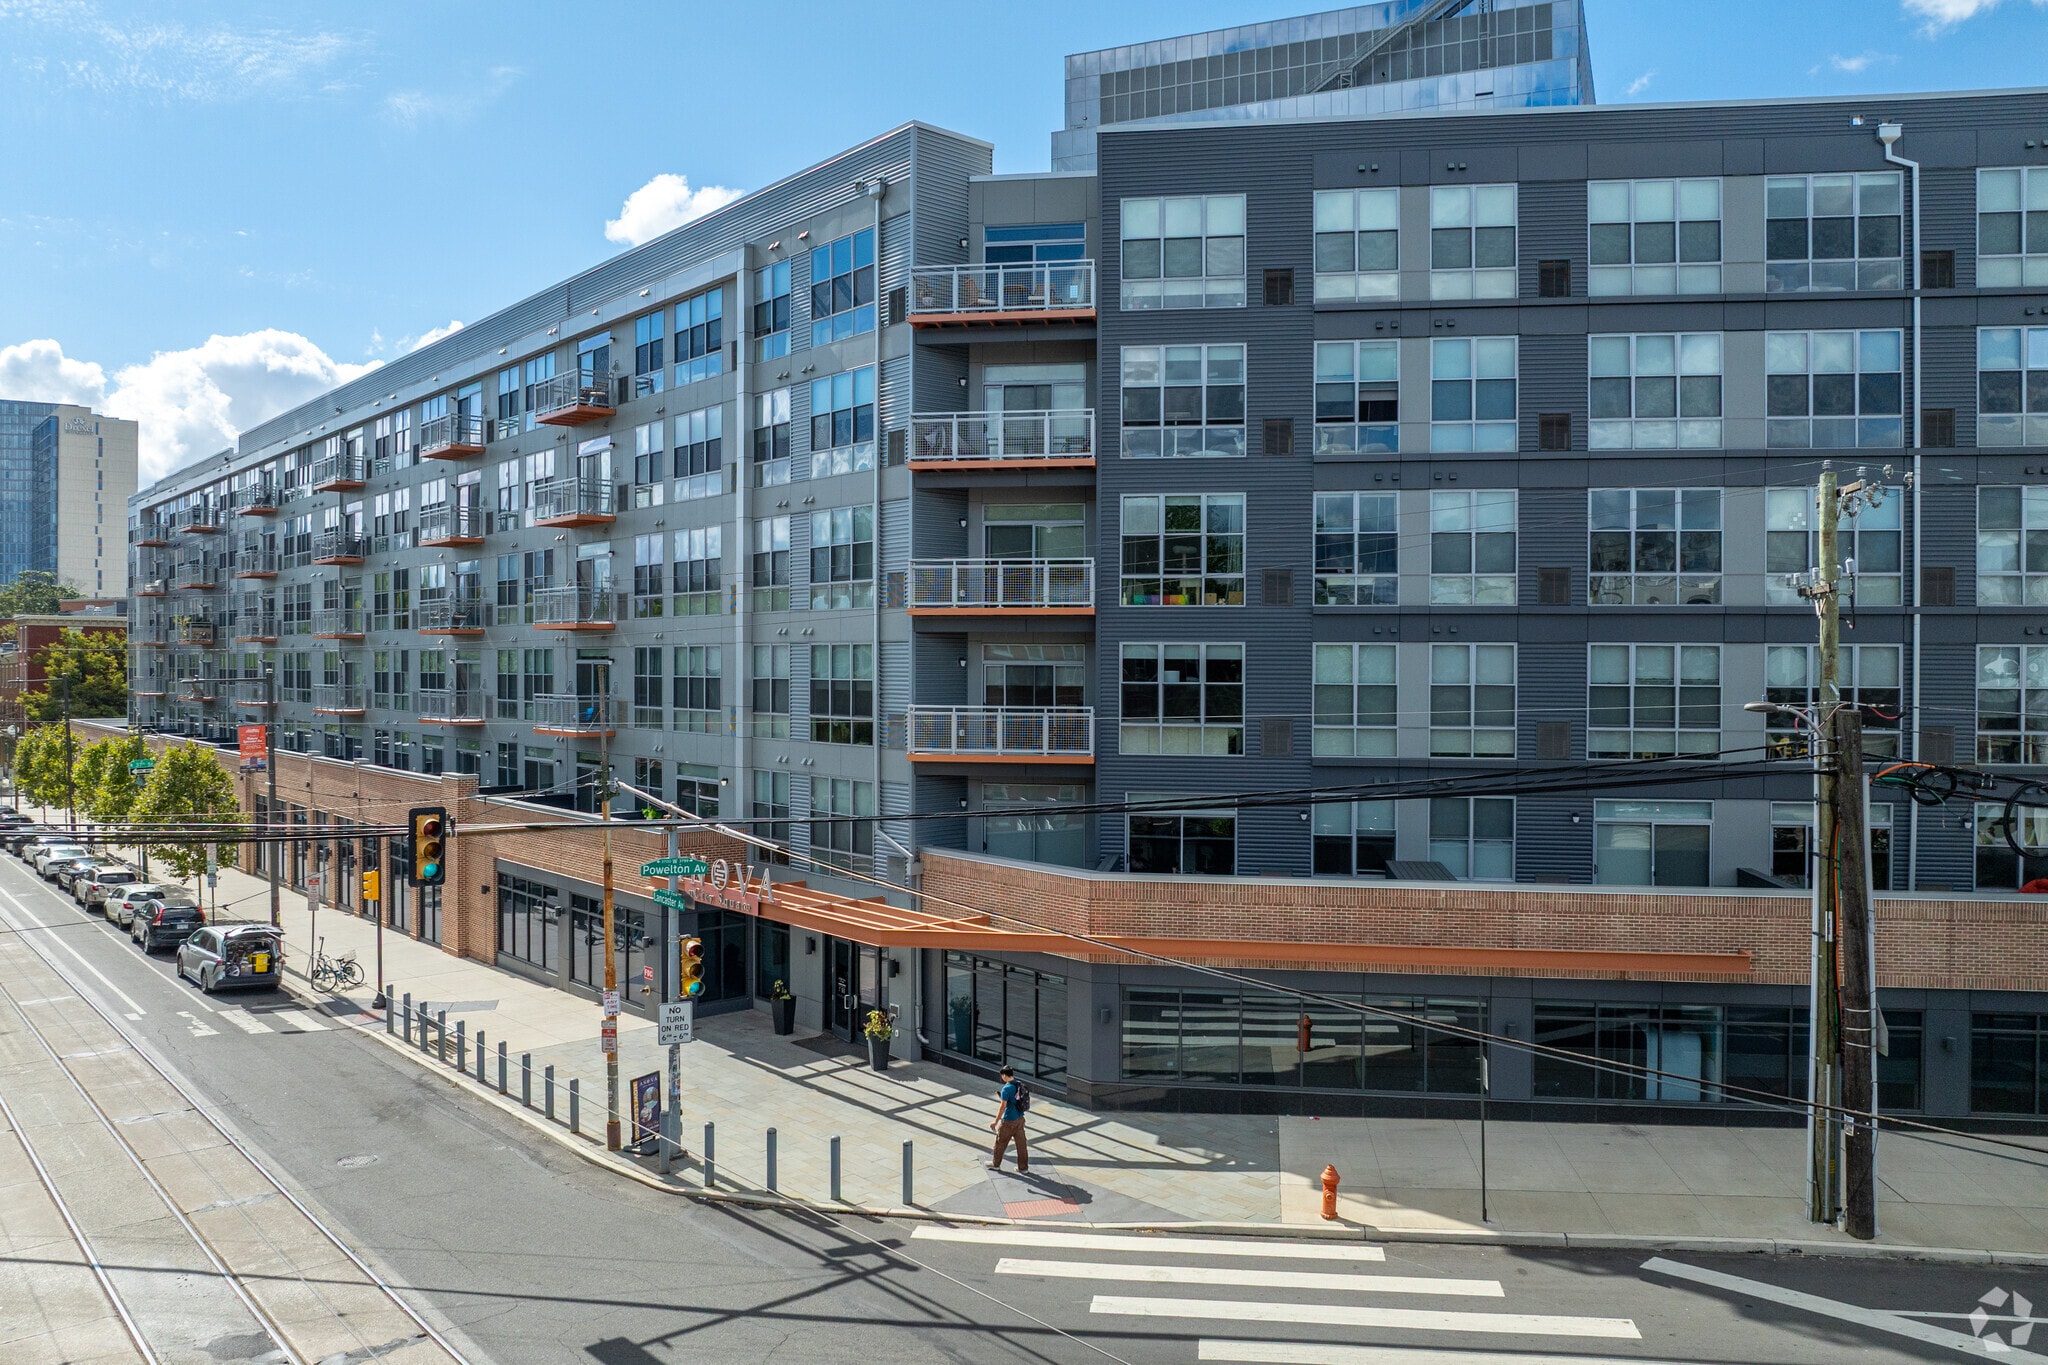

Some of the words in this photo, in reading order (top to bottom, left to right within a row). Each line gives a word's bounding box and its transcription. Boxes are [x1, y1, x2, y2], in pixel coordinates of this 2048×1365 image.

[64, 422, 94, 432] Drexel
[642, 864, 690, 875] Powelton
[694, 864, 707, 873] Av
[679, 849, 775, 903] NOVA
[654, 891, 677, 907] Lancaster
[677, 900, 684, 910] Av
